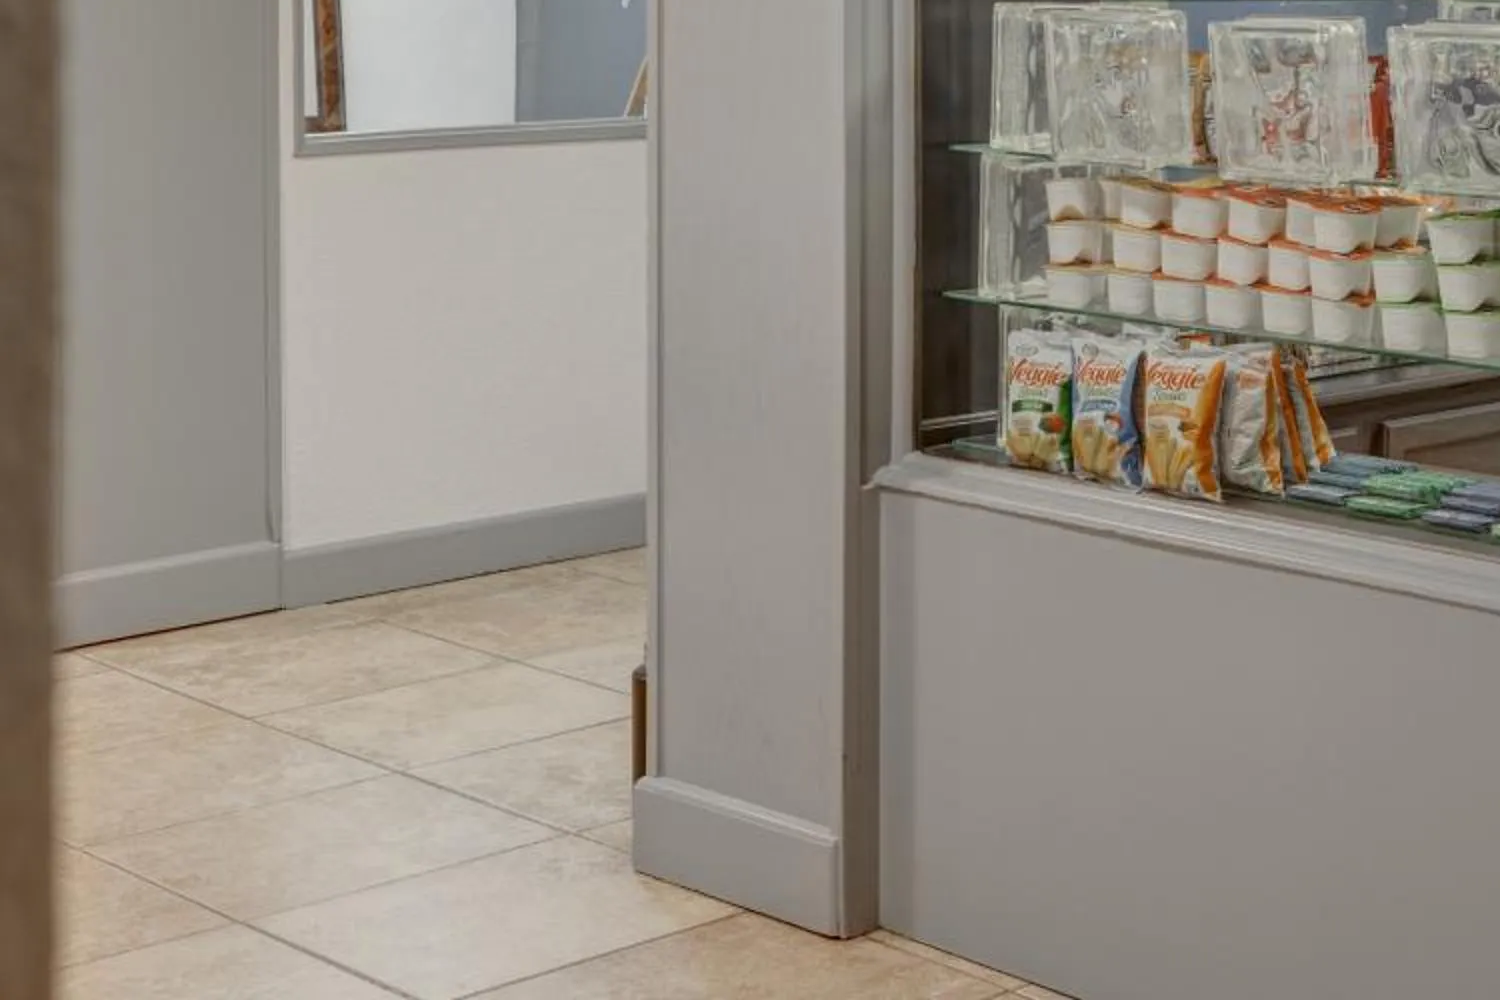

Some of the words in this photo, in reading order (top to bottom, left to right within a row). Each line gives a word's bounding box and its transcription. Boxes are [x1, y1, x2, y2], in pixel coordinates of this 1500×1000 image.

[1010, 357, 1065, 386] Veggie
[1075, 357, 1126, 385] Veggie
[1147, 359, 1204, 390] Veggie
